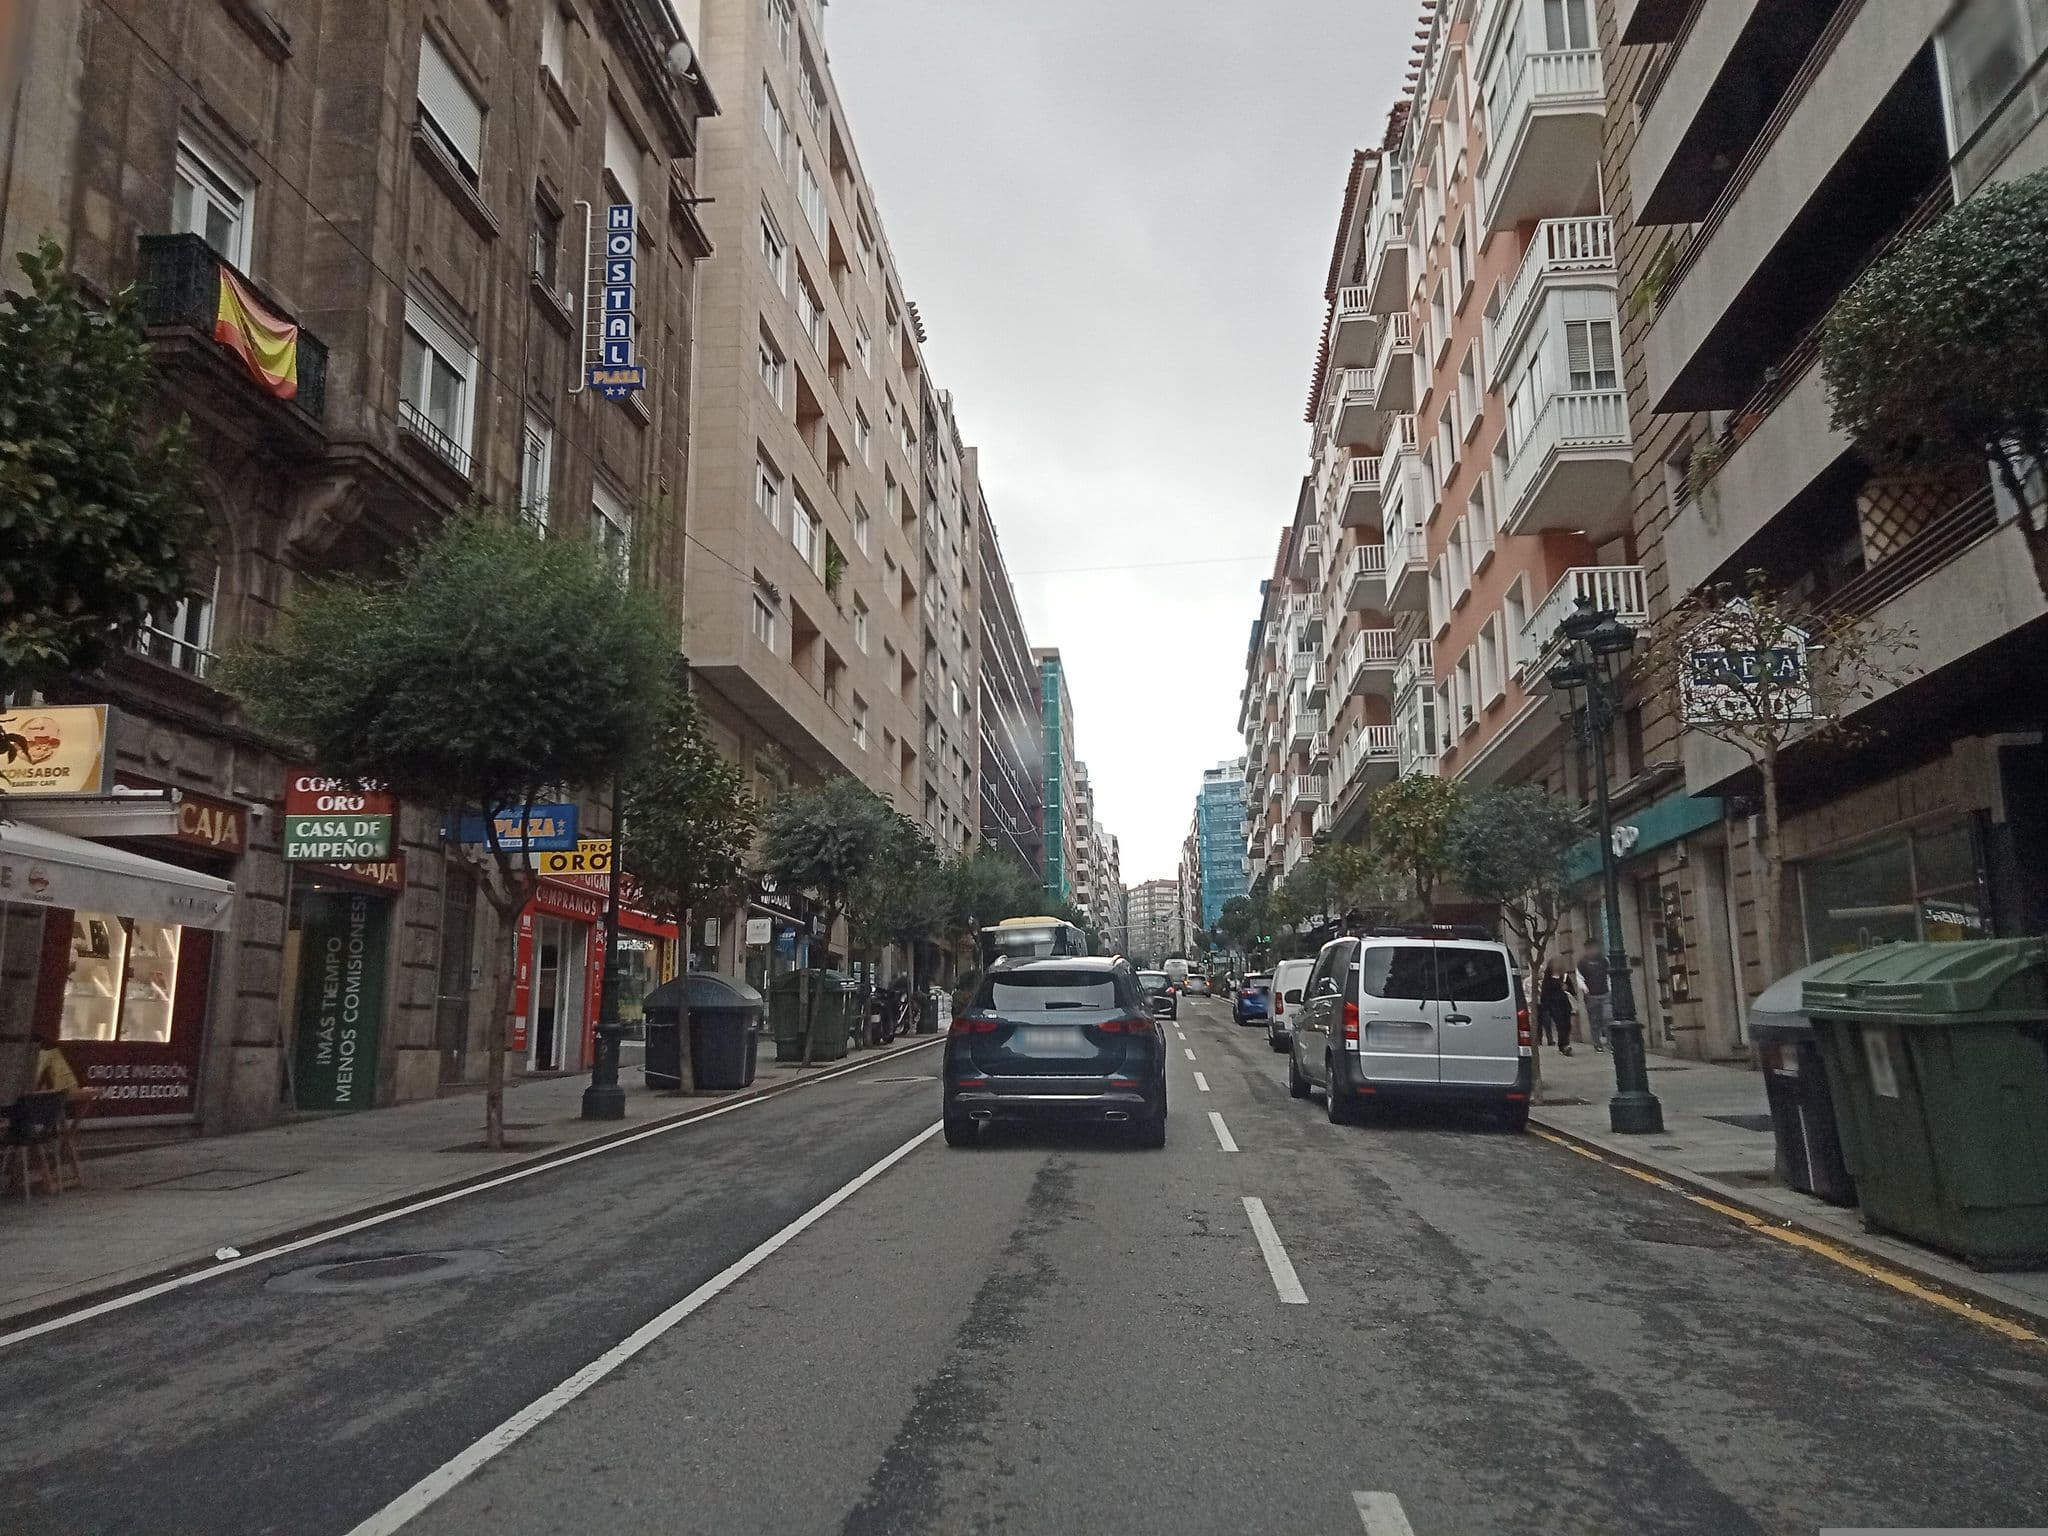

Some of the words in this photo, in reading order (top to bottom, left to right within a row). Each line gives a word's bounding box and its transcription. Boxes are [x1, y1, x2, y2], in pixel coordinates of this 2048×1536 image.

[610, 209, 631, 364] HOSTAL
[176, 802, 240, 846] CAJA
[316, 795, 366, 812] ORO
[295, 821, 348, 837] CASA
[353, 821, 381, 837] DE
[549, 853, 608, 871] ORO
[321, 936, 342, 1010] TIEMPO
[335, 1028, 357, 1102] MENOS
